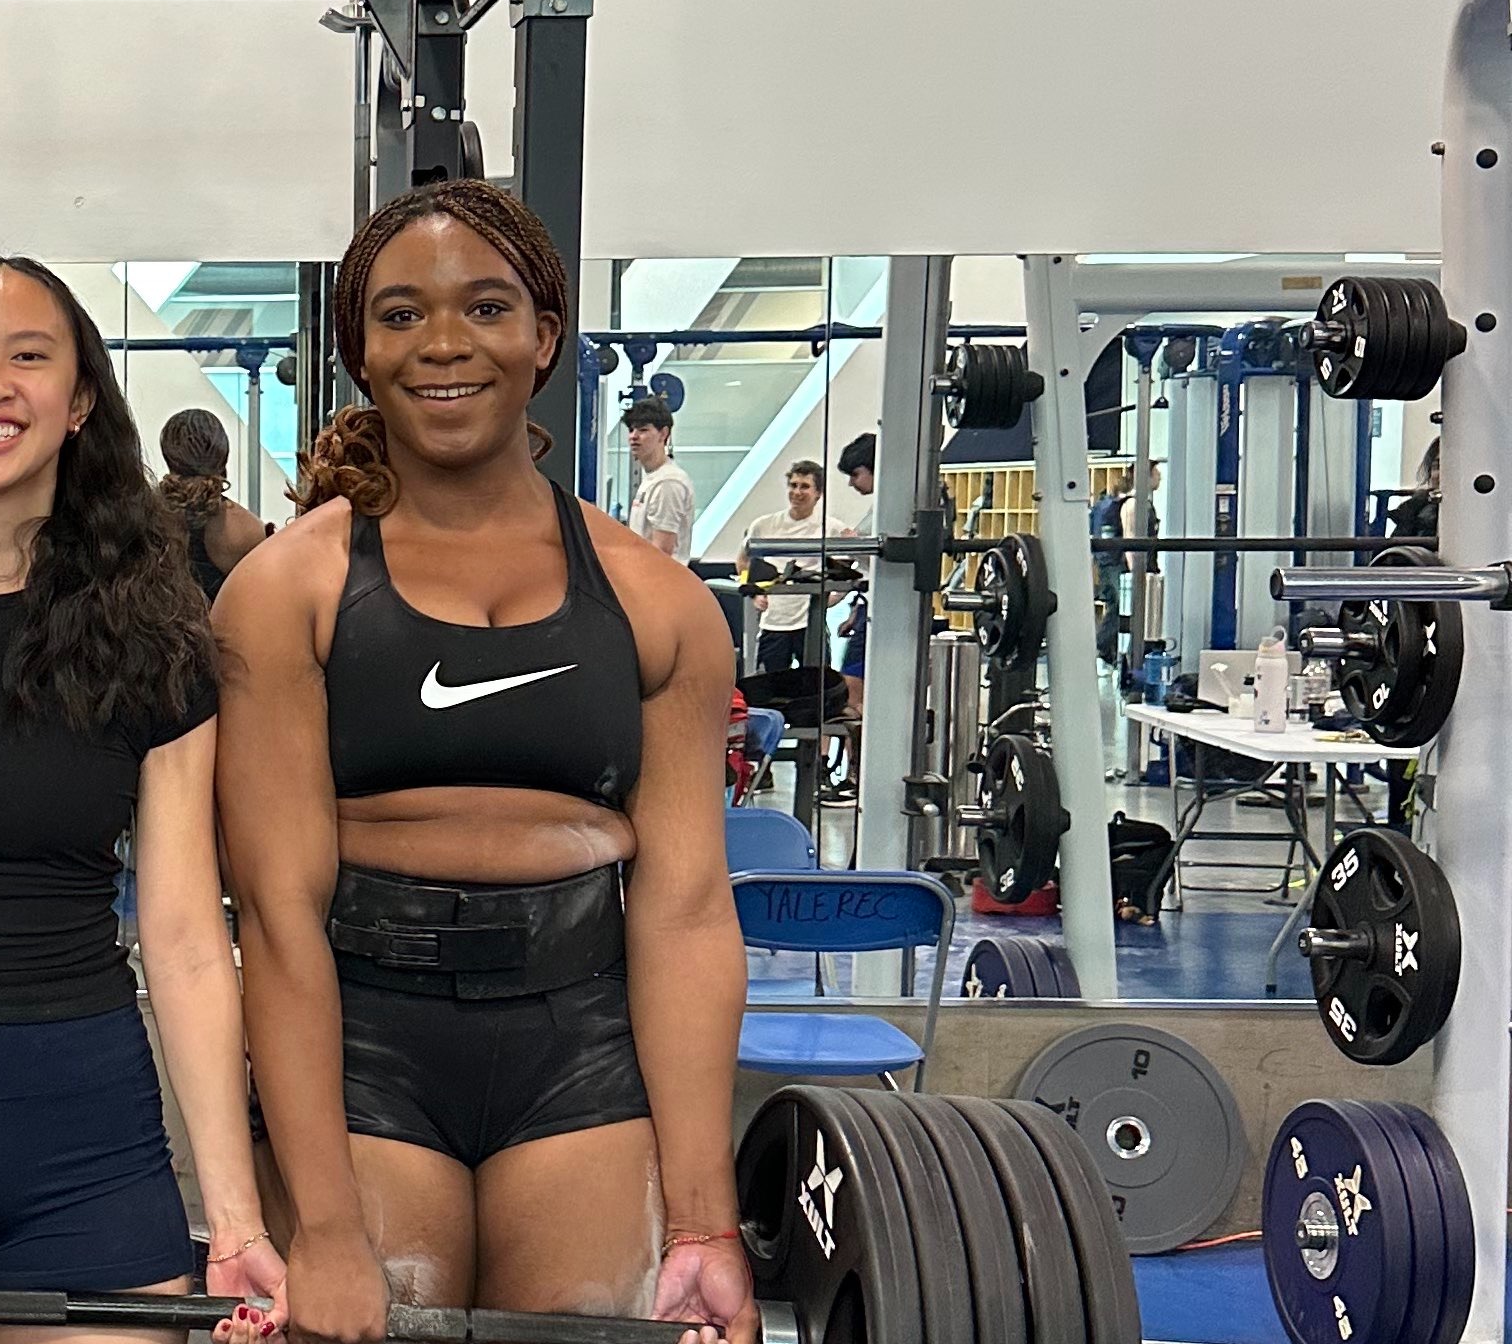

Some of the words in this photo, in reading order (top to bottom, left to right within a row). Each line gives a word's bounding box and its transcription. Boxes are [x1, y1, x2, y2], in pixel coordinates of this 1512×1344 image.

[1331, 848, 1359, 891] 35
[758, 883, 830, 923] YALE
[837, 889, 900, 920] REC
[1328, 997, 1358, 1042] 35
[1131, 1049, 1151, 1080] 10
[798, 1180, 836, 1260] XULT
